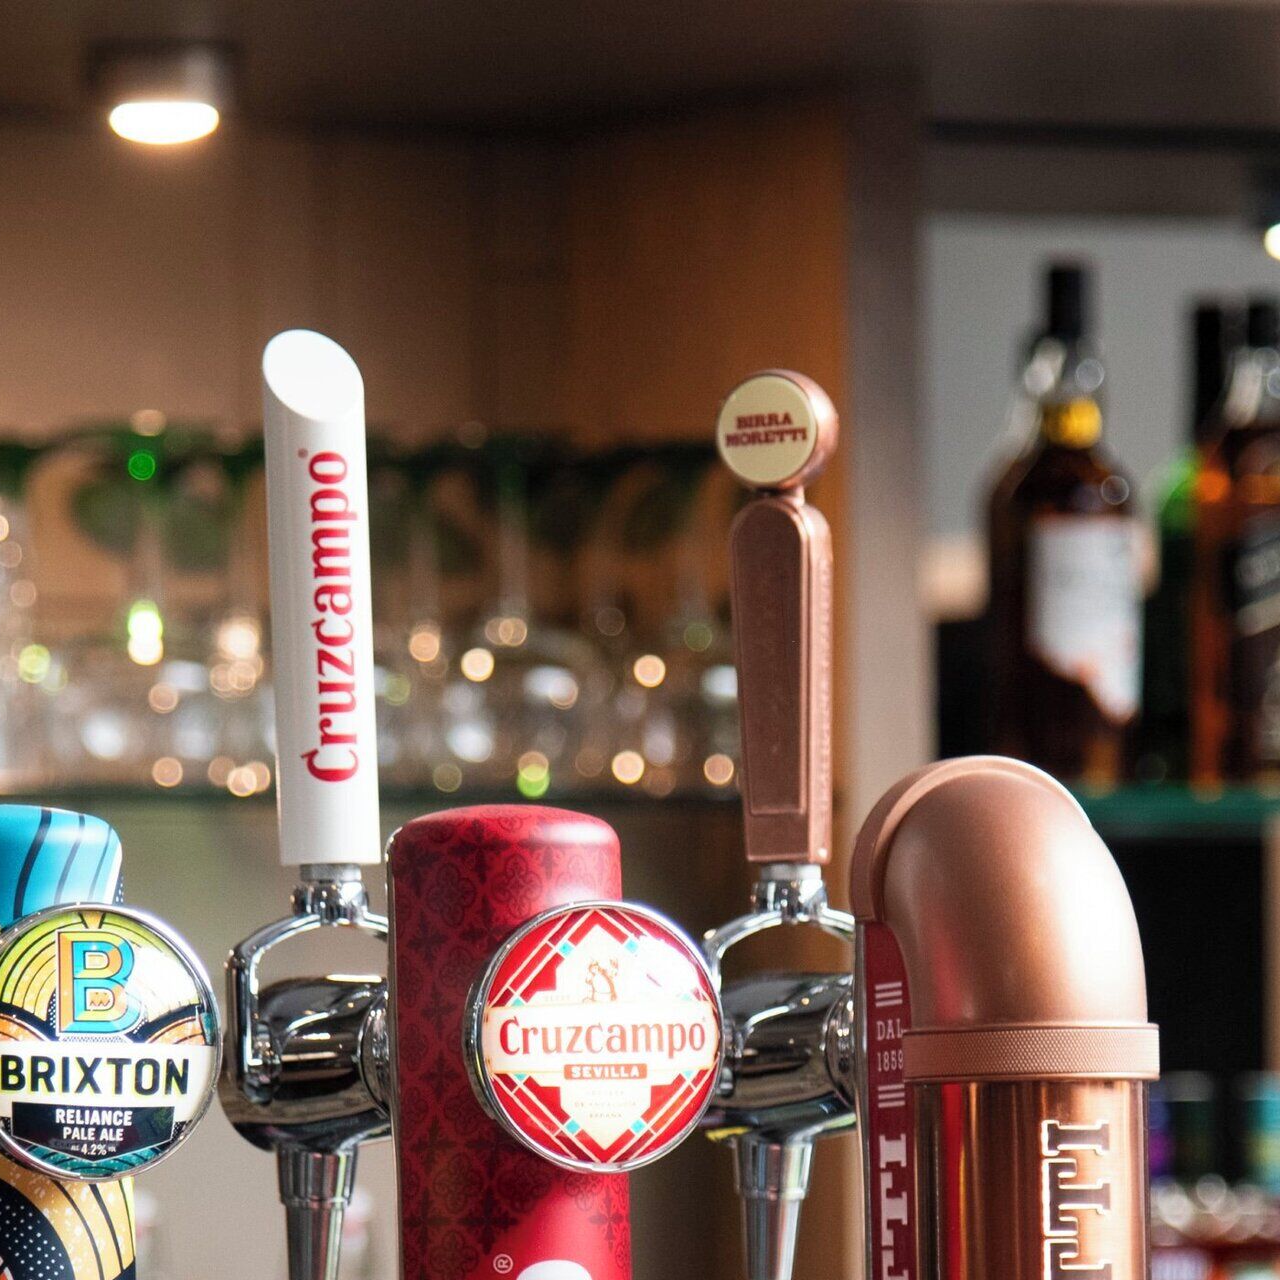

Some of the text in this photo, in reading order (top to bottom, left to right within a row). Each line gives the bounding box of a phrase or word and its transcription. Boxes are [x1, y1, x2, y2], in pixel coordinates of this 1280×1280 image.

[735, 412, 793, 430] BIRRA
[725, 427, 807, 447] MORETTI
[301, 451, 359, 782] Cruzcampo
[56, 929, 145, 1035] B
[499, 1015, 706, 1059] Cruzcampo
[877, 1050, 904, 1072] 1859
[0, 1054, 190, 1096] BRIXTON
[571, 1065, 640, 1078] SEVILLA
[55, 1108, 133, 1127] RELIANCE
[63, 1126, 124, 1142] PALE ALE
[81, 1143, 108, 1156] 4.2%
